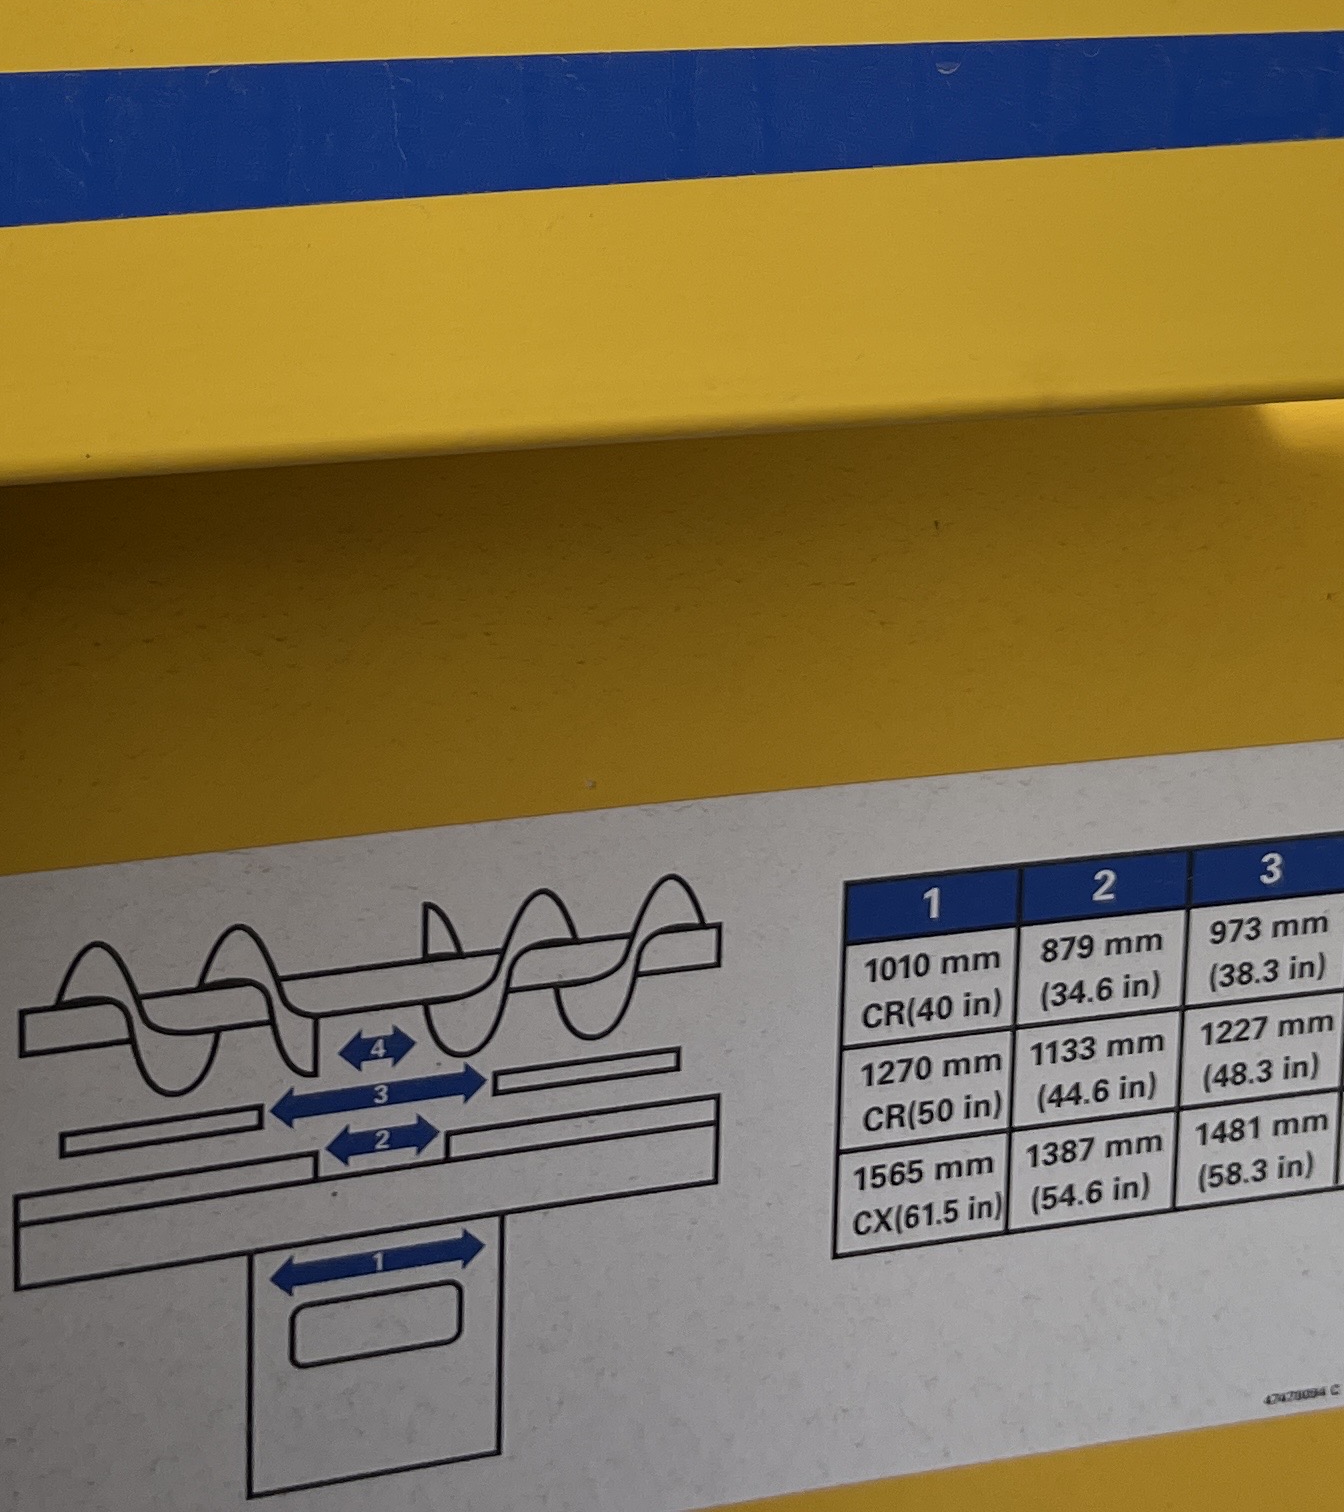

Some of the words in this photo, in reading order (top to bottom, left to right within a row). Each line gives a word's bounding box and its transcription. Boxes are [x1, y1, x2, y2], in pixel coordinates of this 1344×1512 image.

[1093, 870, 1115, 900] 2
[1260, 854, 1282, 884] 3
[924, 888, 938, 918] 1
[1210, 916, 1262, 944] 973
[1272, 916, 1328, 938] mm
[1040, 934, 1094, 962] 879
[1104, 934, 1162, 956] mm
[865, 952, 930, 982] 1010
[941, 952, 1000, 974] mm
[1210, 959, 1280, 992] (38.3
[1289, 952, 1326, 980] in)
[1041, 977, 1114, 1012] (34.6
[1123, 970, 1160, 999] in)
[862, 996, 954, 1028] CR(40
[964, 988, 1002, 1018] in)
[1201, 1016, 1268, 1046] 1227
[1278, 1014, 1334, 1037] mm
[370, 1039, 386, 1058] 4
[1030, 1036, 1096, 1066] 1133
[1106, 1034, 1164, 1057] mm
[861, 1056, 932, 1086] 1270
[942, 1054, 1002, 1077] mm
[1204, 1060, 1274, 1093] (48.3
[1283, 1052, 1320, 1080] in)
[374, 1085, 388, 1104] 3
[1038, 1079, 1110, 1114] (44.6
[1119, 1072, 1156, 1100] in)
[863, 1098, 954, 1132] CR(50
[964, 1090, 1002, 1120] in)
[374, 1130, 390, 1149] 2
[1196, 1116, 1260, 1146] 1481
[1272, 1114, 1328, 1136] mm
[1026, 1136, 1095, 1168] 1387
[1106, 1134, 1163, 1158] mm
[854, 1159, 924, 1191] 1565
[935, 1156, 994, 1180] mm
[1198, 1158, 1268, 1193] (58.3
[1278, 1150, 1314, 1179] in)
[1032, 1180, 1102, 1216] (54.6
[1113, 1172, 1150, 1200] in)
[853, 1199, 958, 1236] CX(61.5
[968, 1191, 1002, 1223] in)
[373, 1252, 384, 1271] 1
